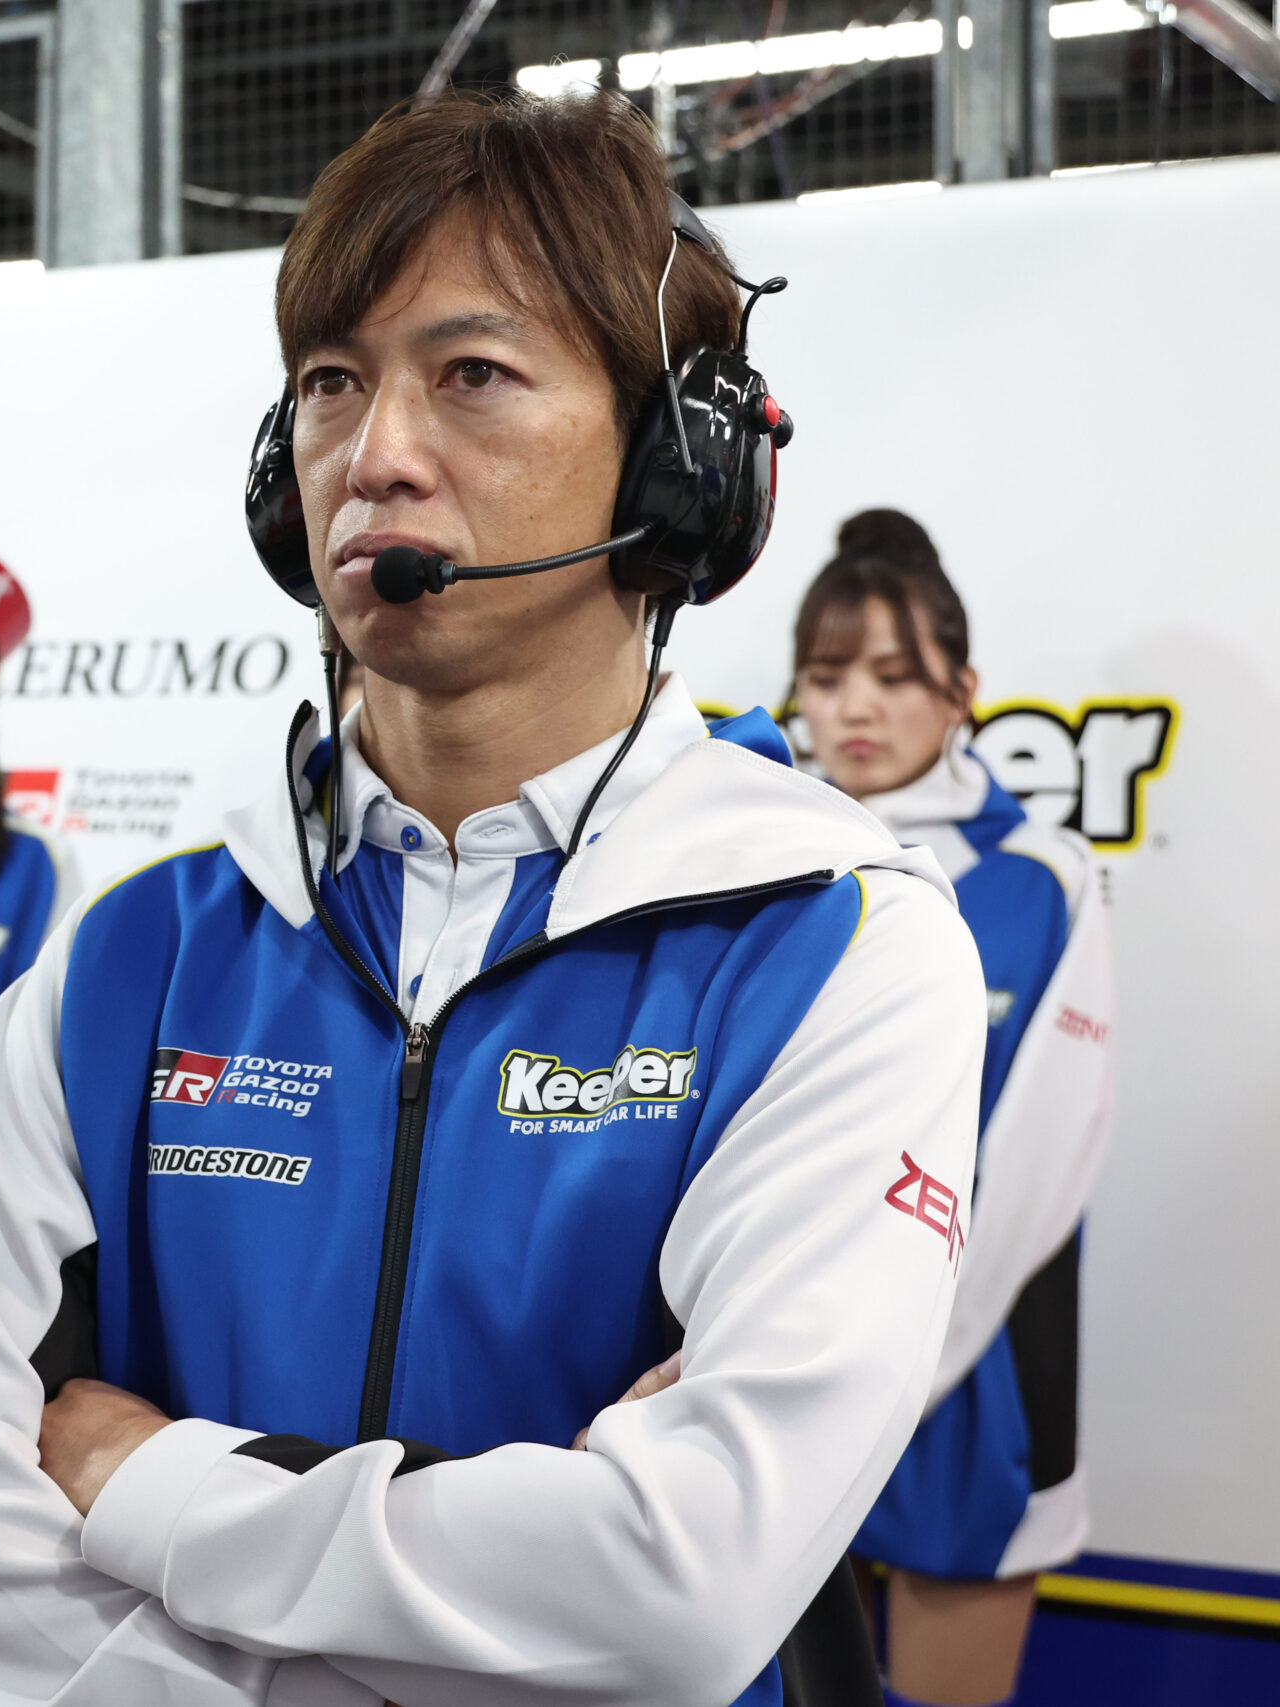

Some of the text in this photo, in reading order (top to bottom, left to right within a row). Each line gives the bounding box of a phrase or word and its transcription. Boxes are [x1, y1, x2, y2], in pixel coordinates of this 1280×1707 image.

[2, 632, 290, 698] ERUMO
[232, 1054, 333, 1080] TOYOTA
[500, 1047, 696, 1115] KeePer
[222, 1071, 320, 1097] GAZOO
[216, 1089, 312, 1118] Racing
[509, 1104, 679, 1136] FOR SMART CAR LIFE
[148, 1144, 311, 1185] RIDGESTONE
